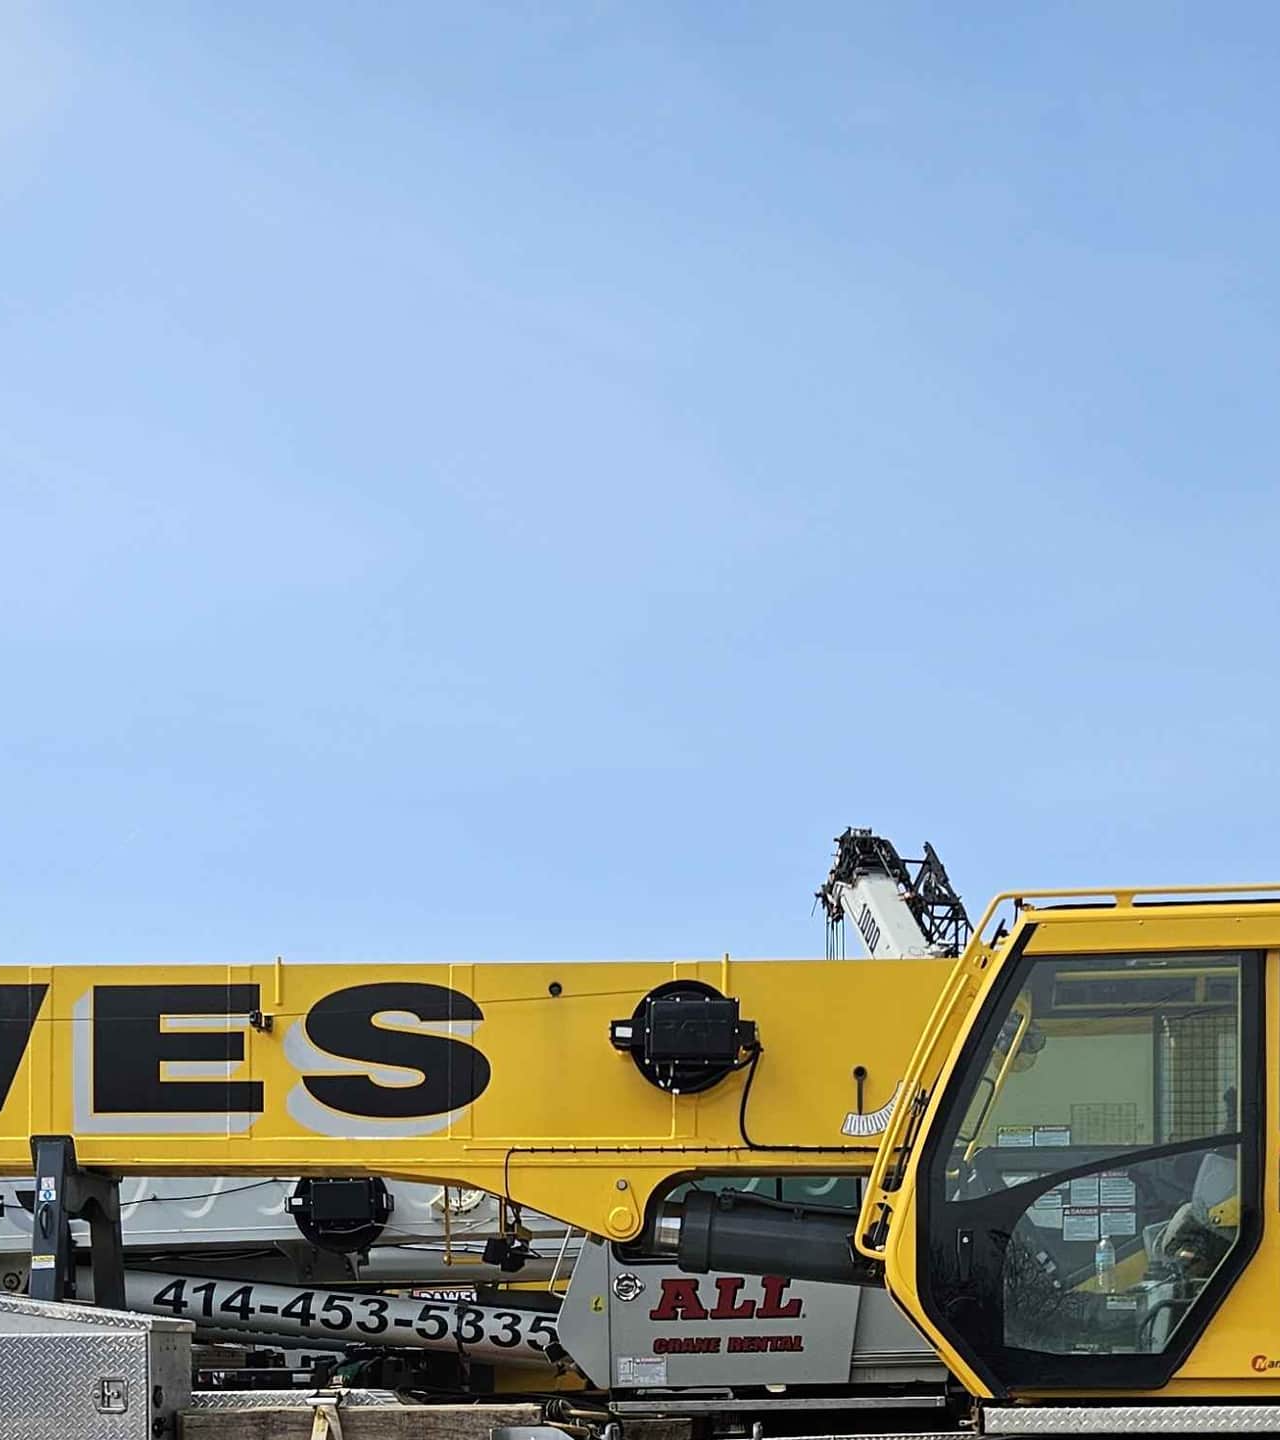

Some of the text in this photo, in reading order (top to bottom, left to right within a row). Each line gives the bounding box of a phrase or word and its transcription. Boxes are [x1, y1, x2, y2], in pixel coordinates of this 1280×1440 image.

[152, 1278, 560, 1352] 414-453-5335
[649, 1275, 803, 1321] ALL
[653, 1335, 805, 1354] CRANE RENTAL
